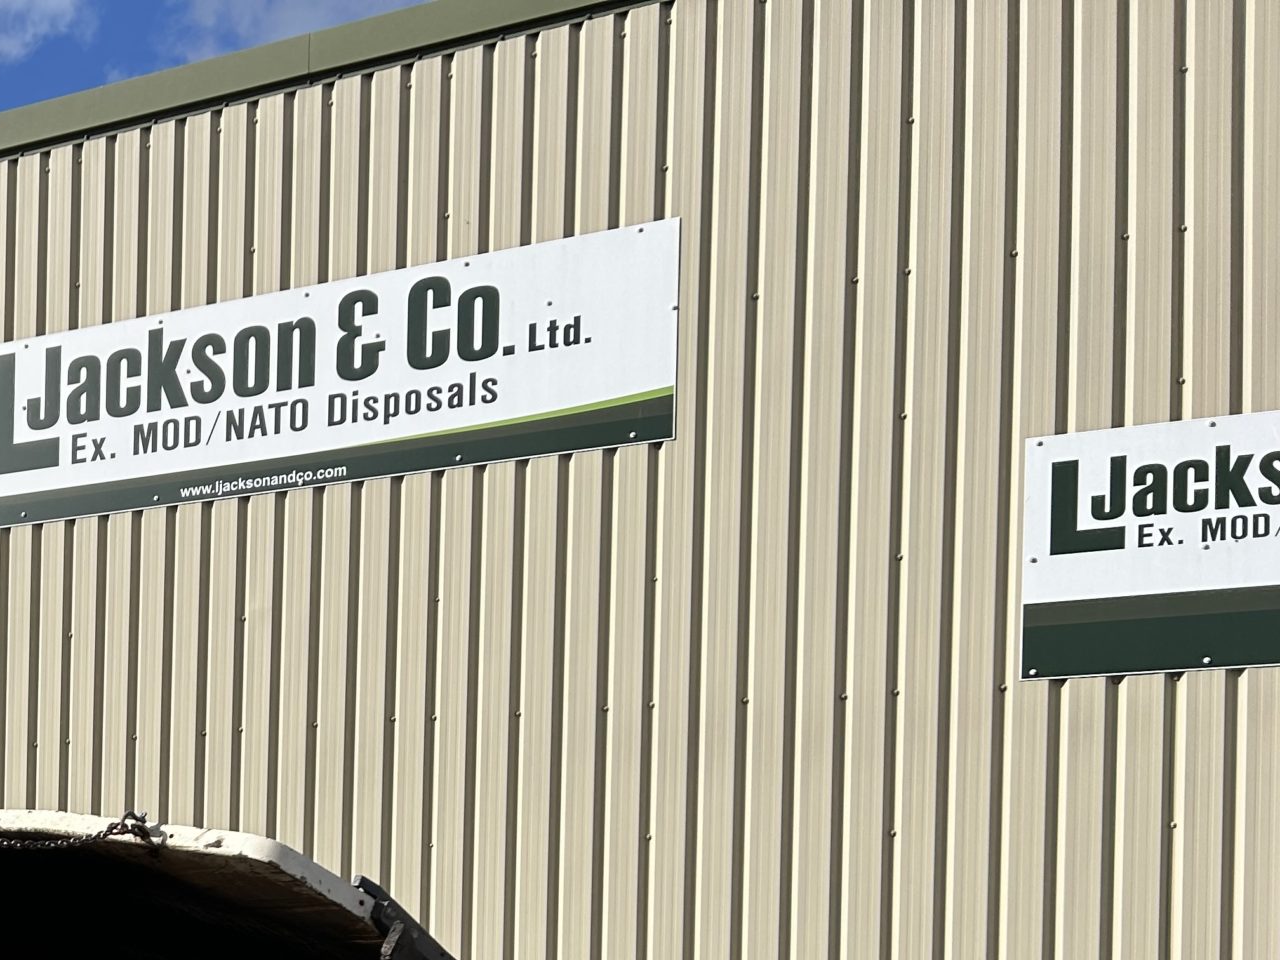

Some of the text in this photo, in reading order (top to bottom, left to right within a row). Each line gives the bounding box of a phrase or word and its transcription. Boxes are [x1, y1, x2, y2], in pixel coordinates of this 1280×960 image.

[336, 289, 386, 382] &
[407, 276, 516, 371] Co.
[528, 315, 592, 353] Ltd.
[71, 372, 498, 465] Ex. MOD/NATO Disposals
[180, 465, 347, 498] www.ljacksonandco.com
[1137, 523, 1184, 548] Ex.
